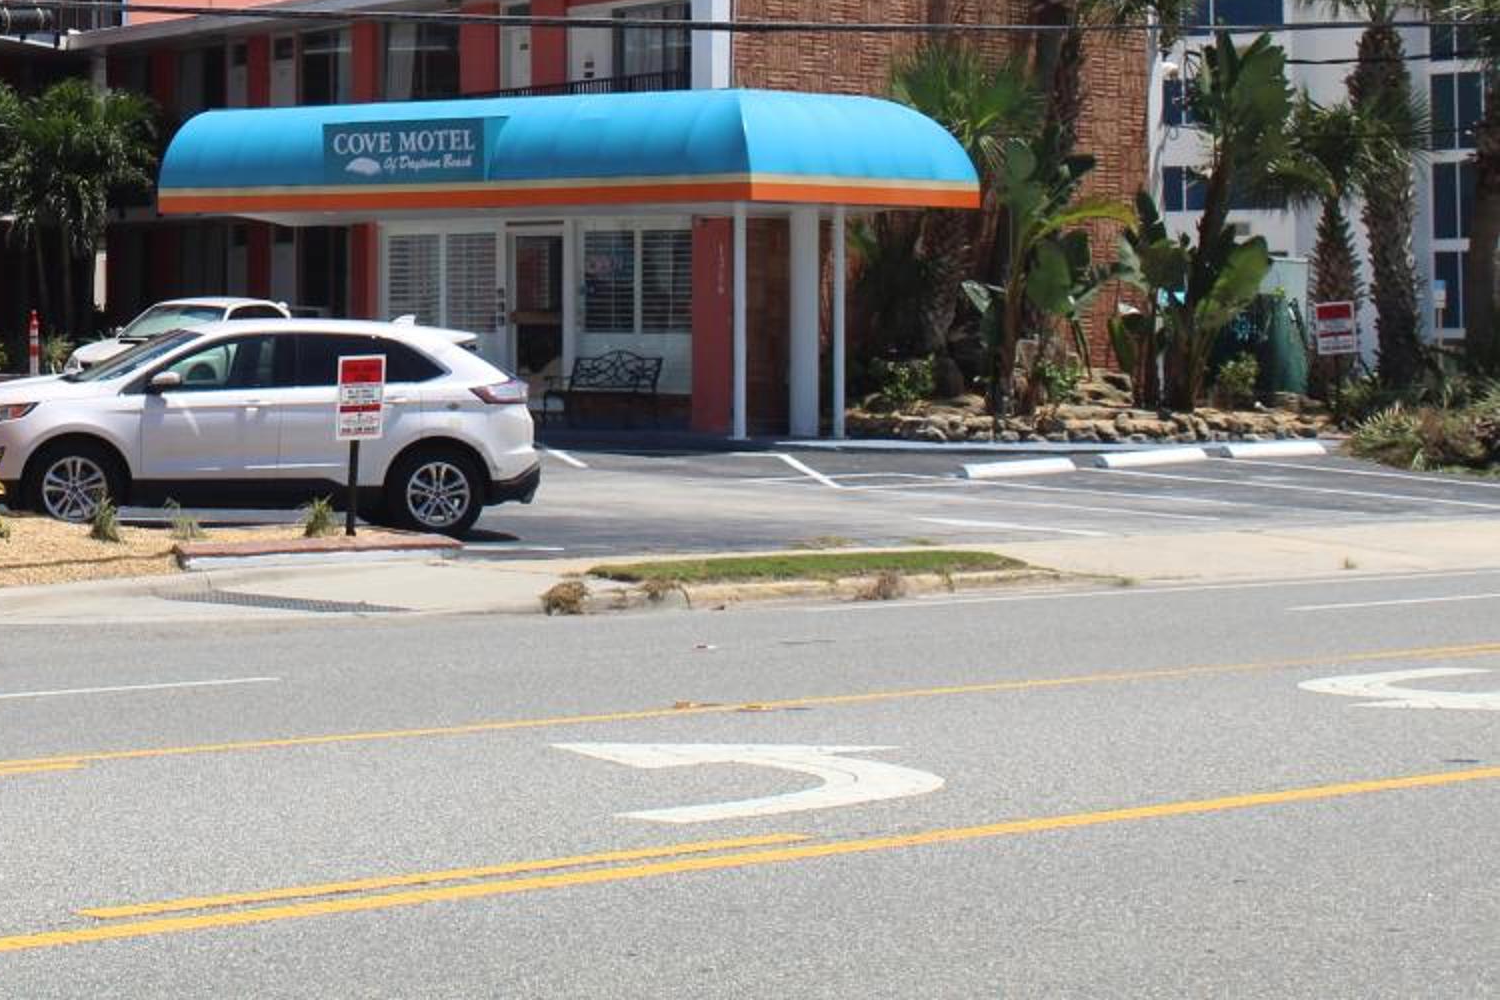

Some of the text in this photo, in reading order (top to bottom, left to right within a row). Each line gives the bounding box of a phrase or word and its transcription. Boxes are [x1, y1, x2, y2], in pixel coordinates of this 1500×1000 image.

[333, 129, 476, 155] COVE MOTEL
[399, 154, 442, 173] Daytona
[443, 152, 473, 169] Beach
